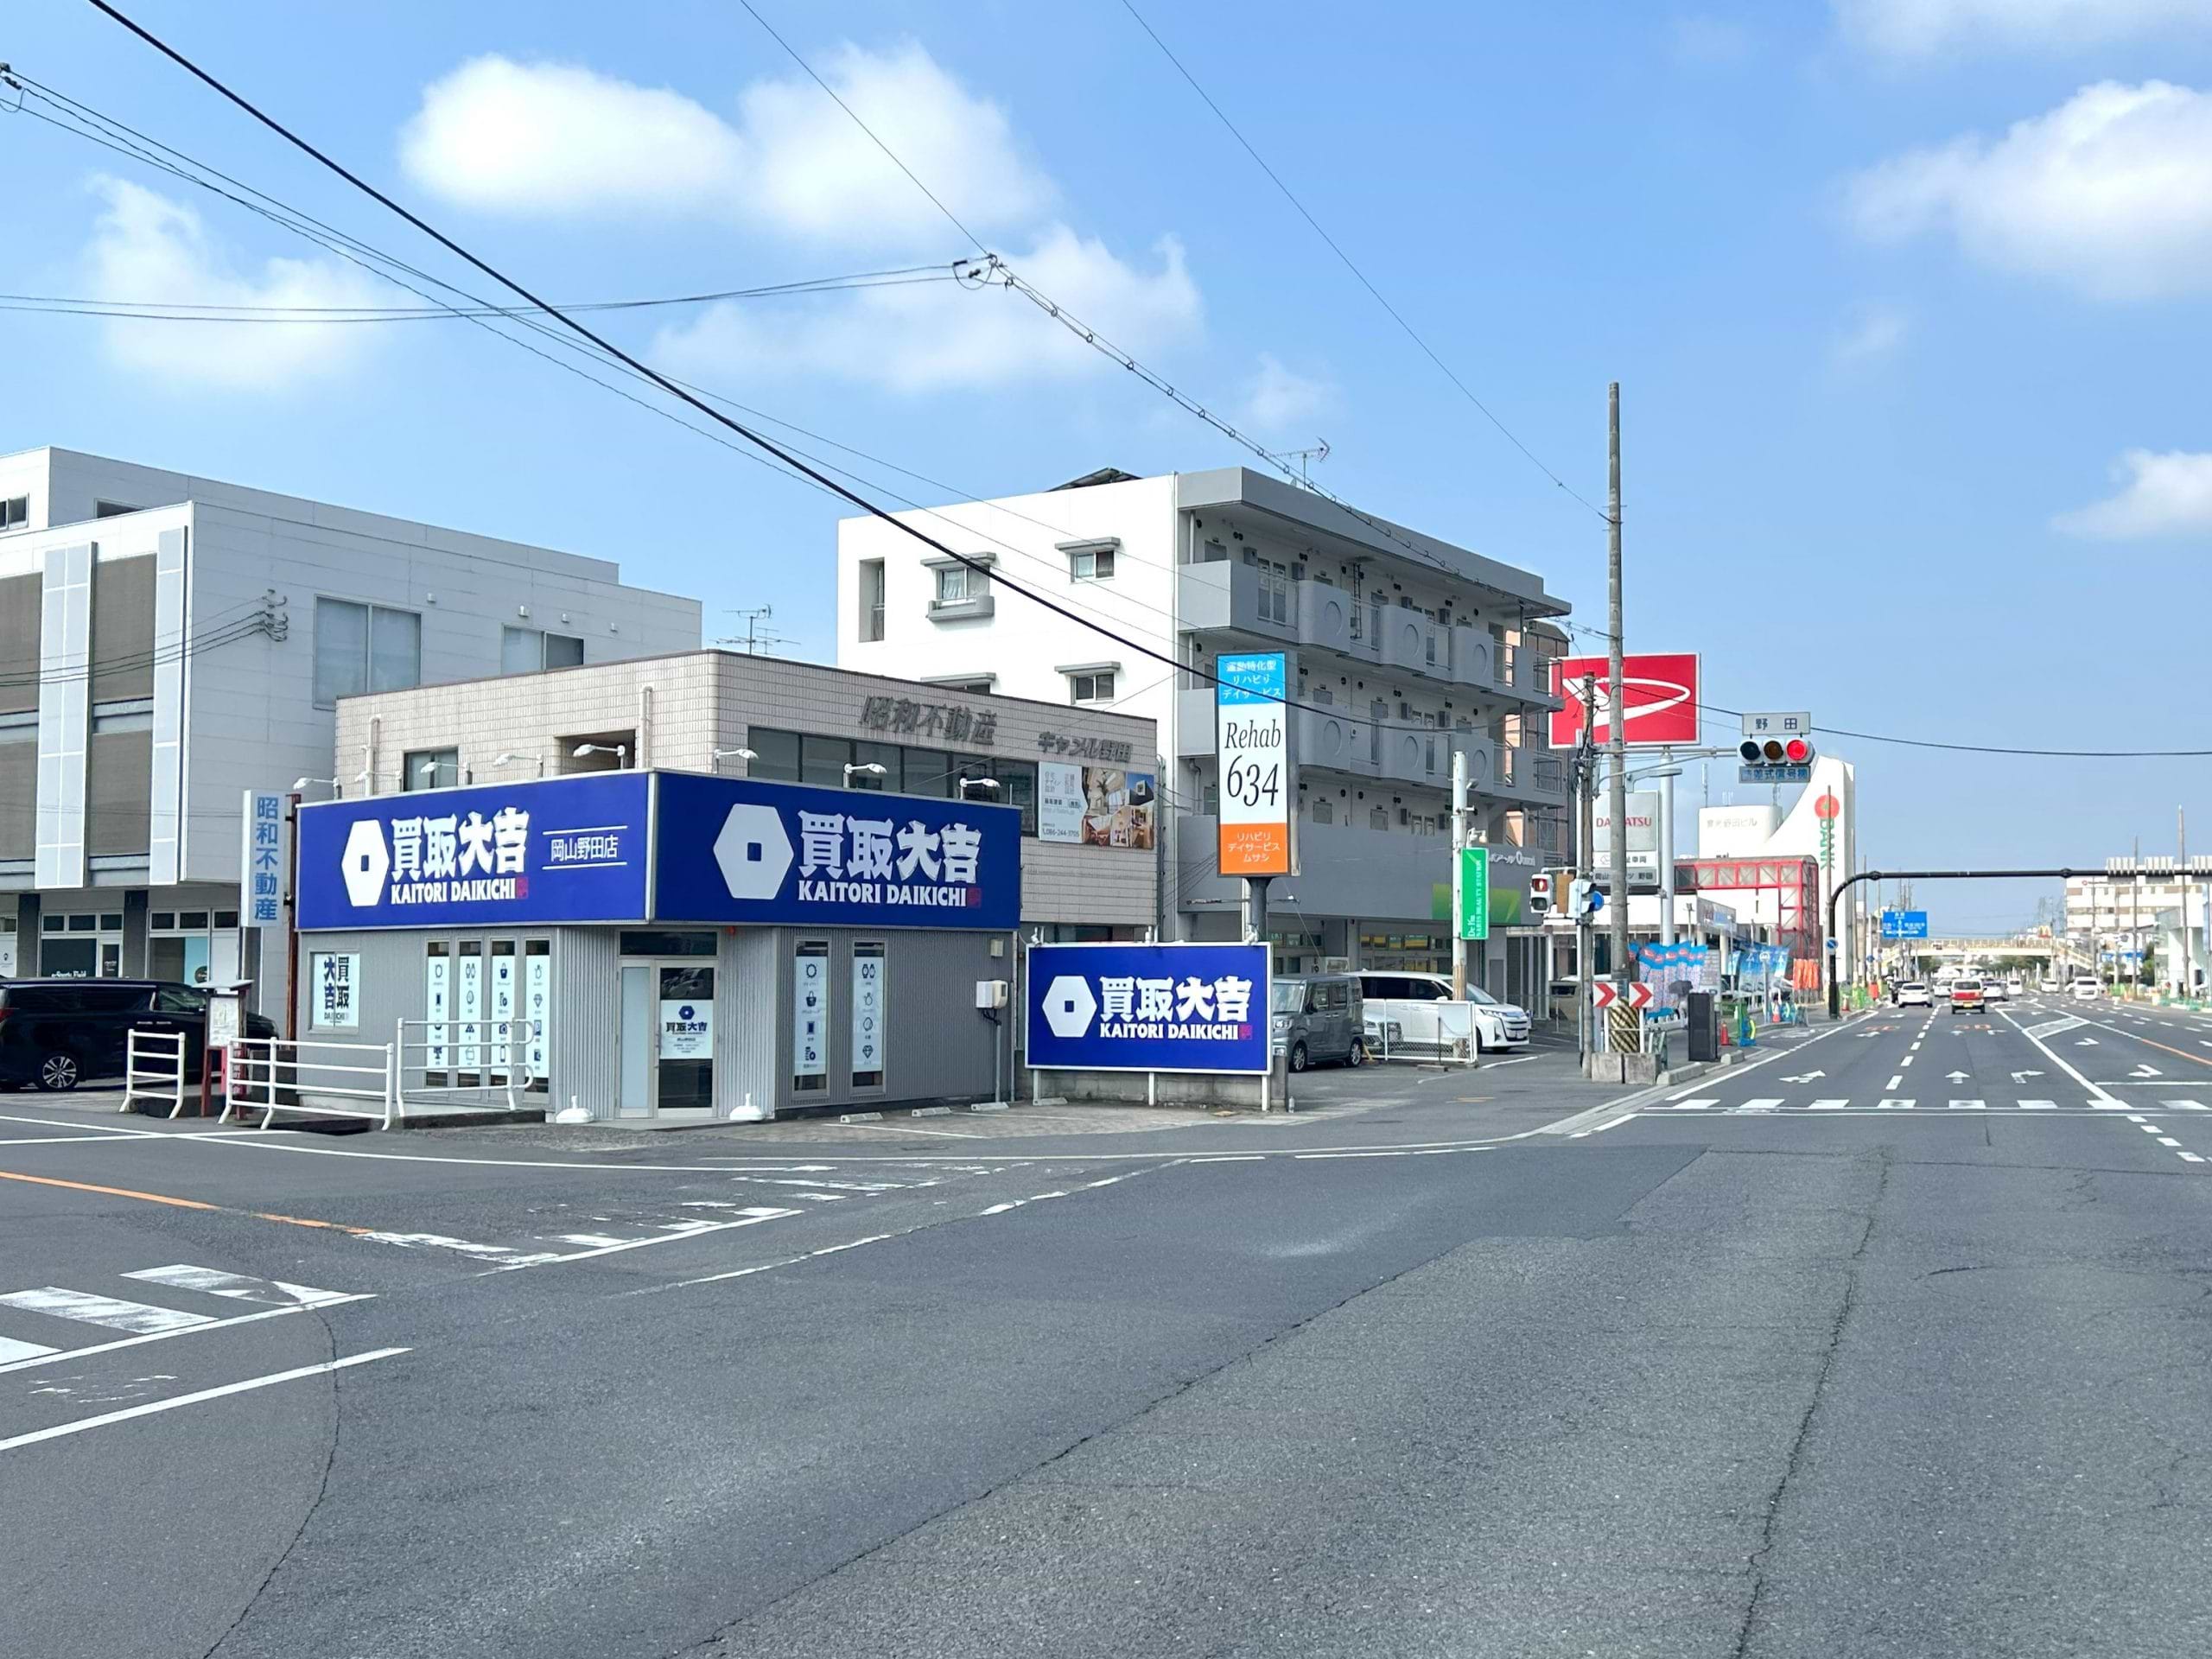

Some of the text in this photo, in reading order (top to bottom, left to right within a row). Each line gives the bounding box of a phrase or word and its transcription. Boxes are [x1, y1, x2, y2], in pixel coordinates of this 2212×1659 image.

[1233, 674, 1270, 685] リハビリ
[1223, 687, 1281, 700] デイサビス
[859, 694, 997, 746] 昭和不動産
[1755, 718, 1797, 730] 野田
[1224, 719, 1281, 749] Rehab
[1227, 754, 1279, 807] 634
[1596, 817, 1652, 827] DAATSU
[391, 806, 531, 882] 買取大吉
[550, 835, 619, 862] 岡山野田店
[798, 810, 982, 884] 買取大吉
[1228, 842, 1281, 852] デイサービス
[1236, 831, 1271, 842] リハビリ
[254, 797, 279, 921] 昭和不動産
[1243, 853, 1270, 862] ムサシ
[391, 880, 448, 906] KAITORI
[450, 877, 516, 903] DAIKICHI
[798, 880, 881, 904] KAITORI
[886, 884, 967, 907] DAIKICHI
[323, 957, 335, 1010] 大吉
[337, 957, 350, 1010] 買取
[1099, 975, 1253, 1023] 買取大吉
[666, 1022, 708, 1033] 買取大吉
[1099, 1023, 1164, 1039] KAITORI
[1167, 1024, 1239, 1040] DAIKICHI
